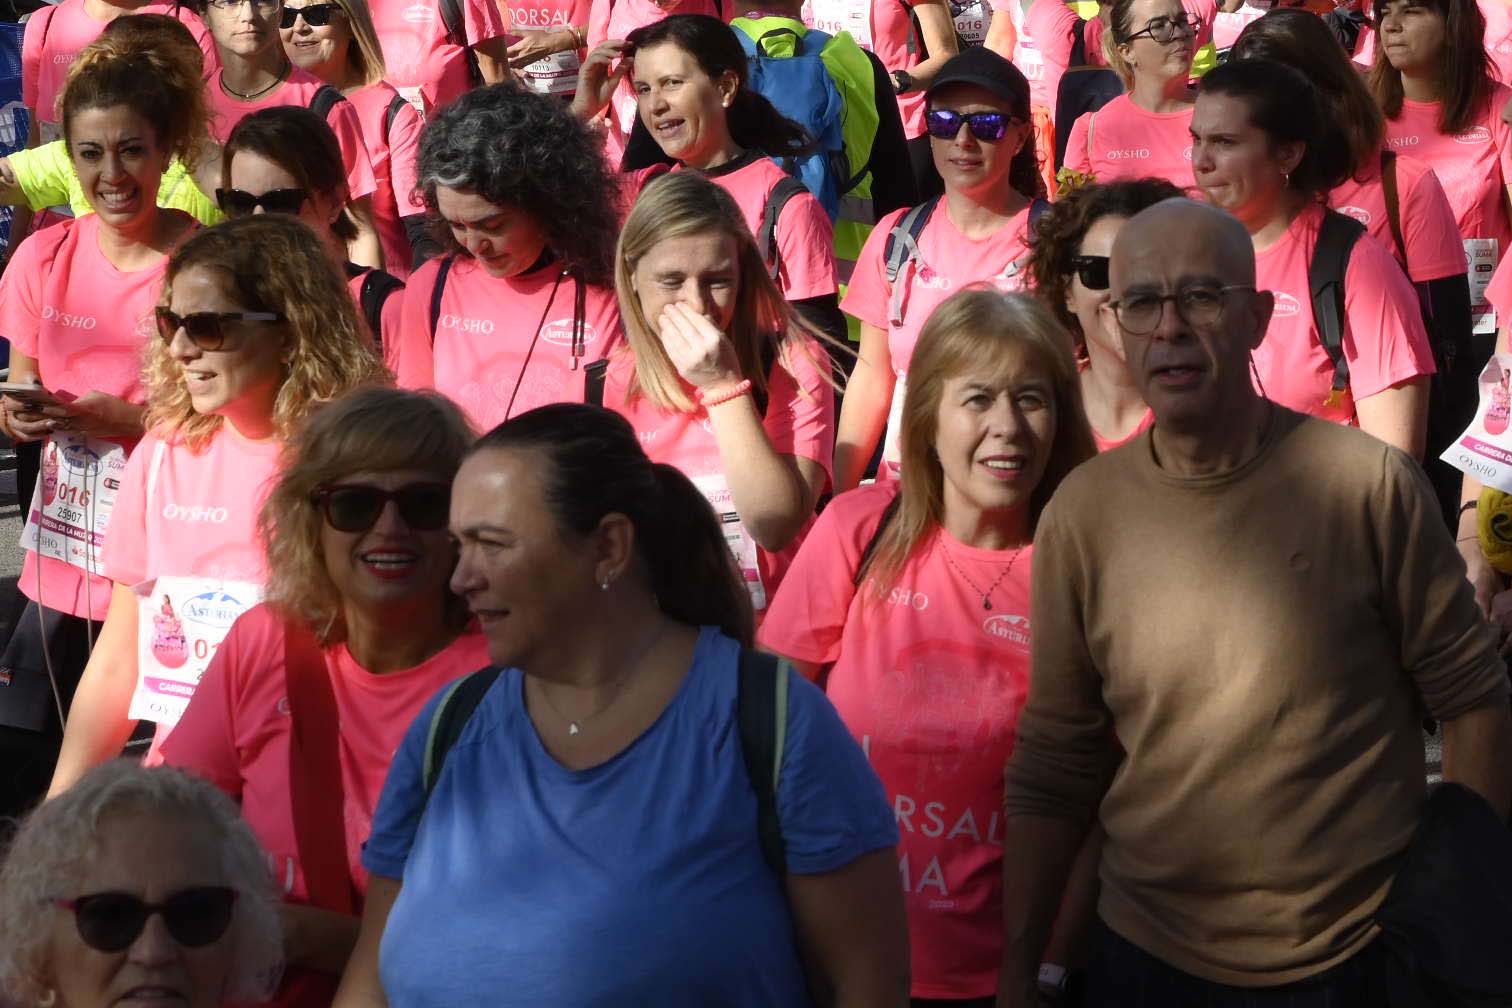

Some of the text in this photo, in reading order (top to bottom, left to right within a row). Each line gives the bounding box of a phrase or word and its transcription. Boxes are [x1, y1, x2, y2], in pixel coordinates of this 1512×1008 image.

[957, 20, 982, 31] 016
[1106, 148, 1151, 160] OYSHO
[42, 305, 97, 330] OYSHO
[1459, 455, 1497, 479] OYSHO
[58, 483, 91, 507] 016
[57, 506, 82, 524] 25907
[162, 503, 229, 524] OYSHO
